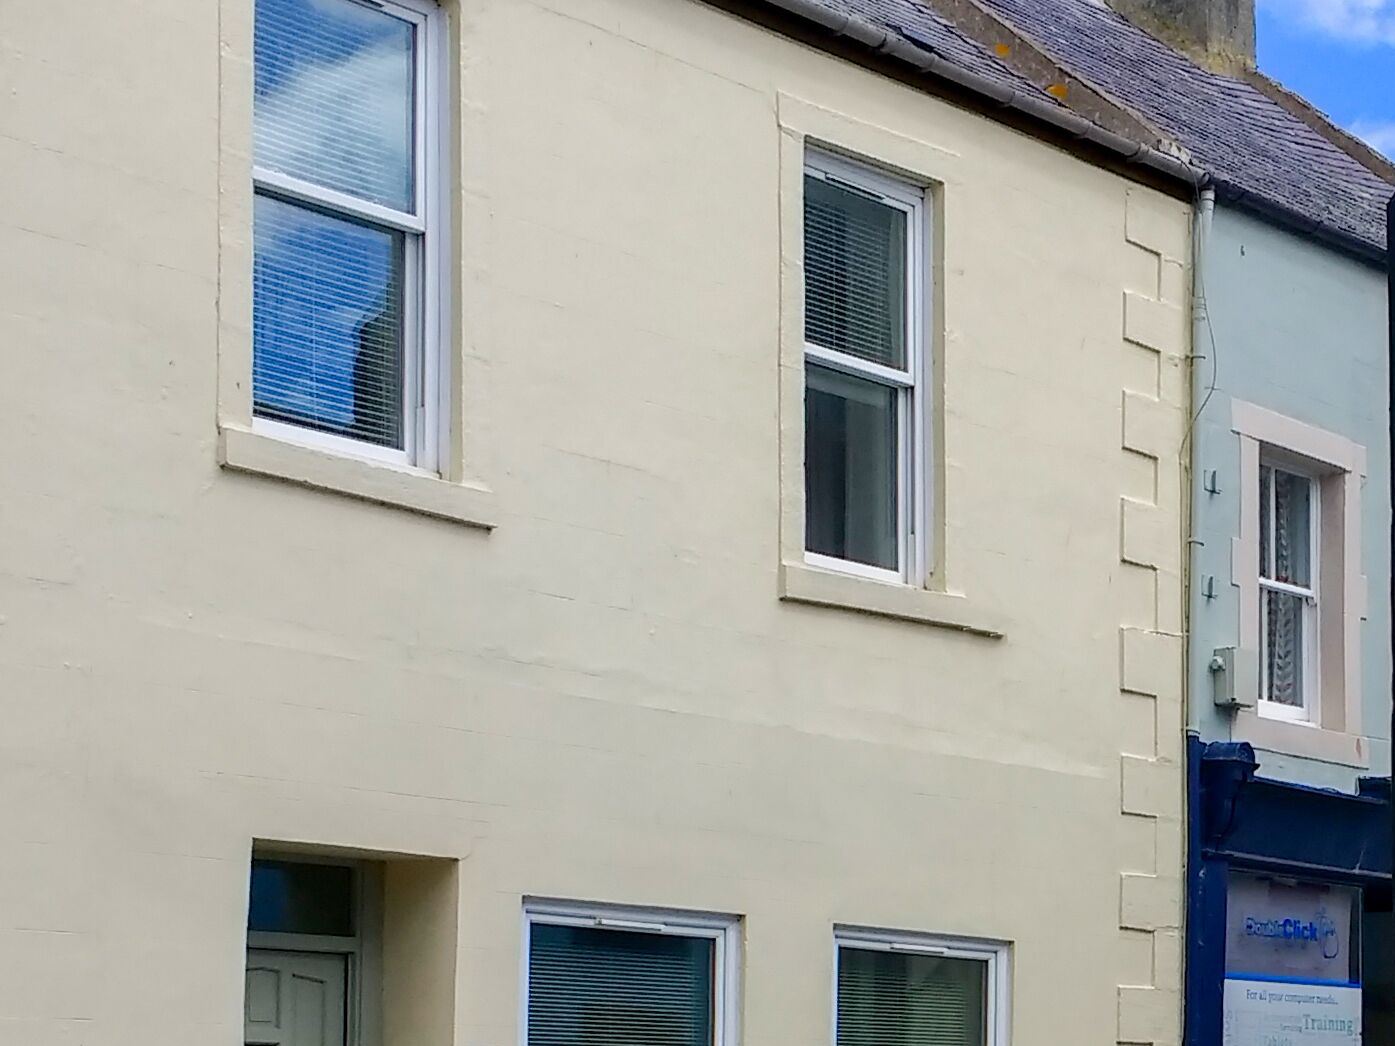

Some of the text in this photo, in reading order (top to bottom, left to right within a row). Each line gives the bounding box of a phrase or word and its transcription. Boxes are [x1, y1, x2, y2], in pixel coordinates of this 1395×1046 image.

[1246, 988, 1258, 1000] For
[1268, 993, 1284, 1004] your
[1302, 1013, 1354, 1036] Training
